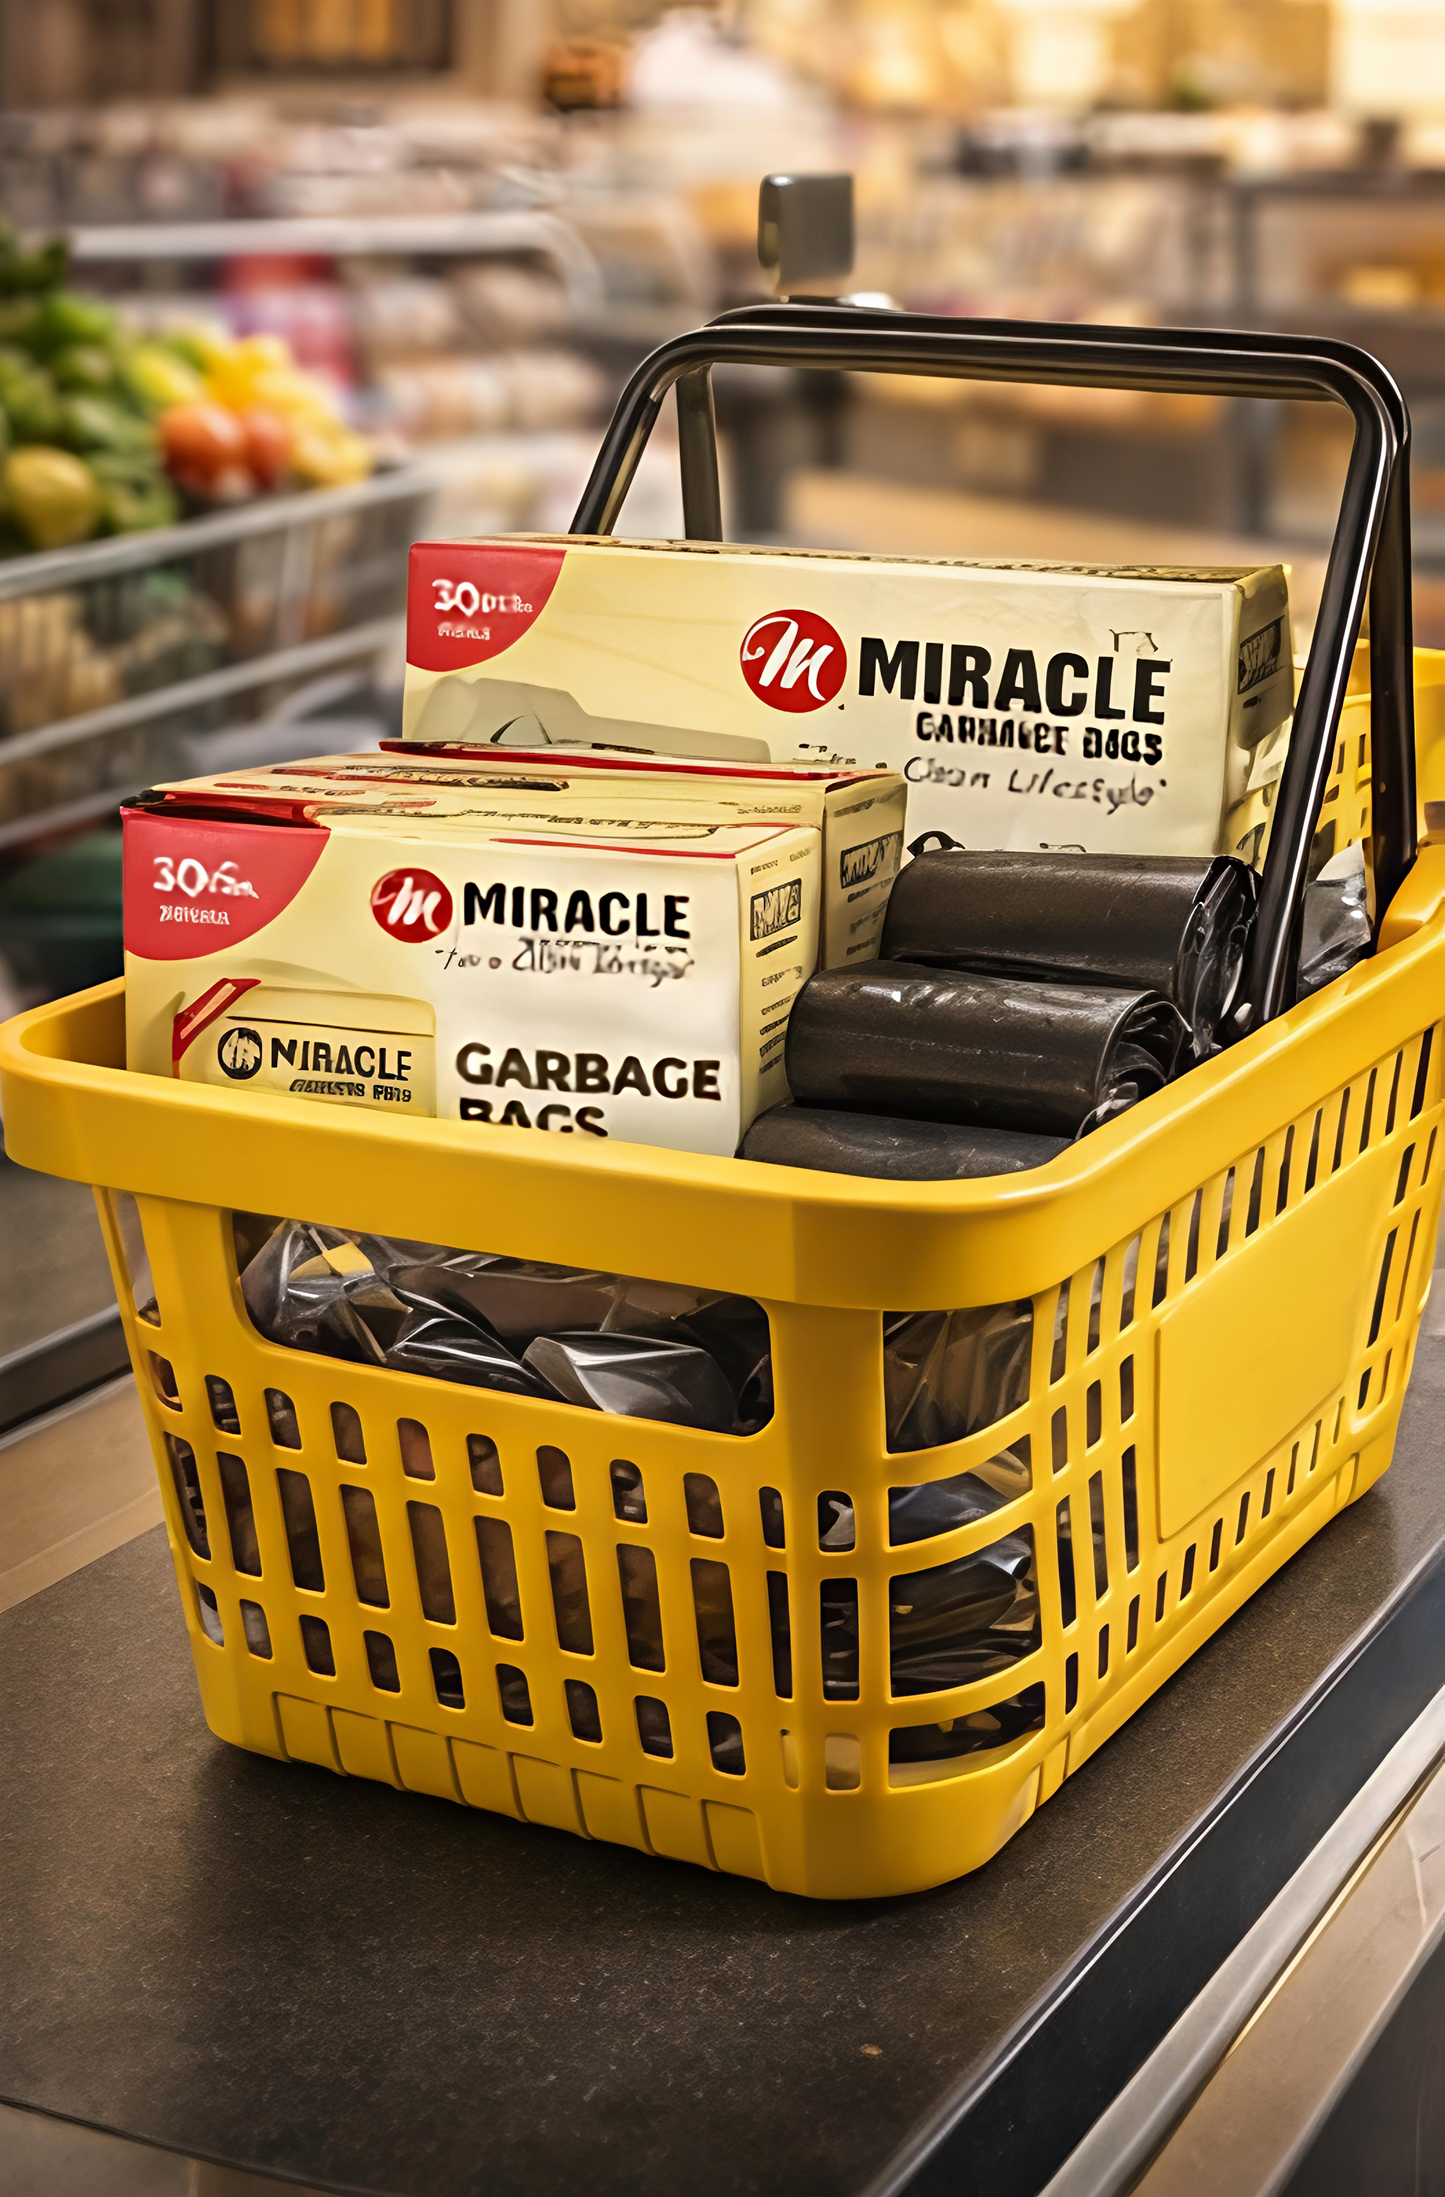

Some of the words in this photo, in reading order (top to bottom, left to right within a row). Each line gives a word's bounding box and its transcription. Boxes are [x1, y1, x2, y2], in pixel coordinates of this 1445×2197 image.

[857, 636, 1171, 725] MIRACLE
[463, 881, 691, 939] MIRACLE
[455, 1041, 722, 1102] GARBAGE
